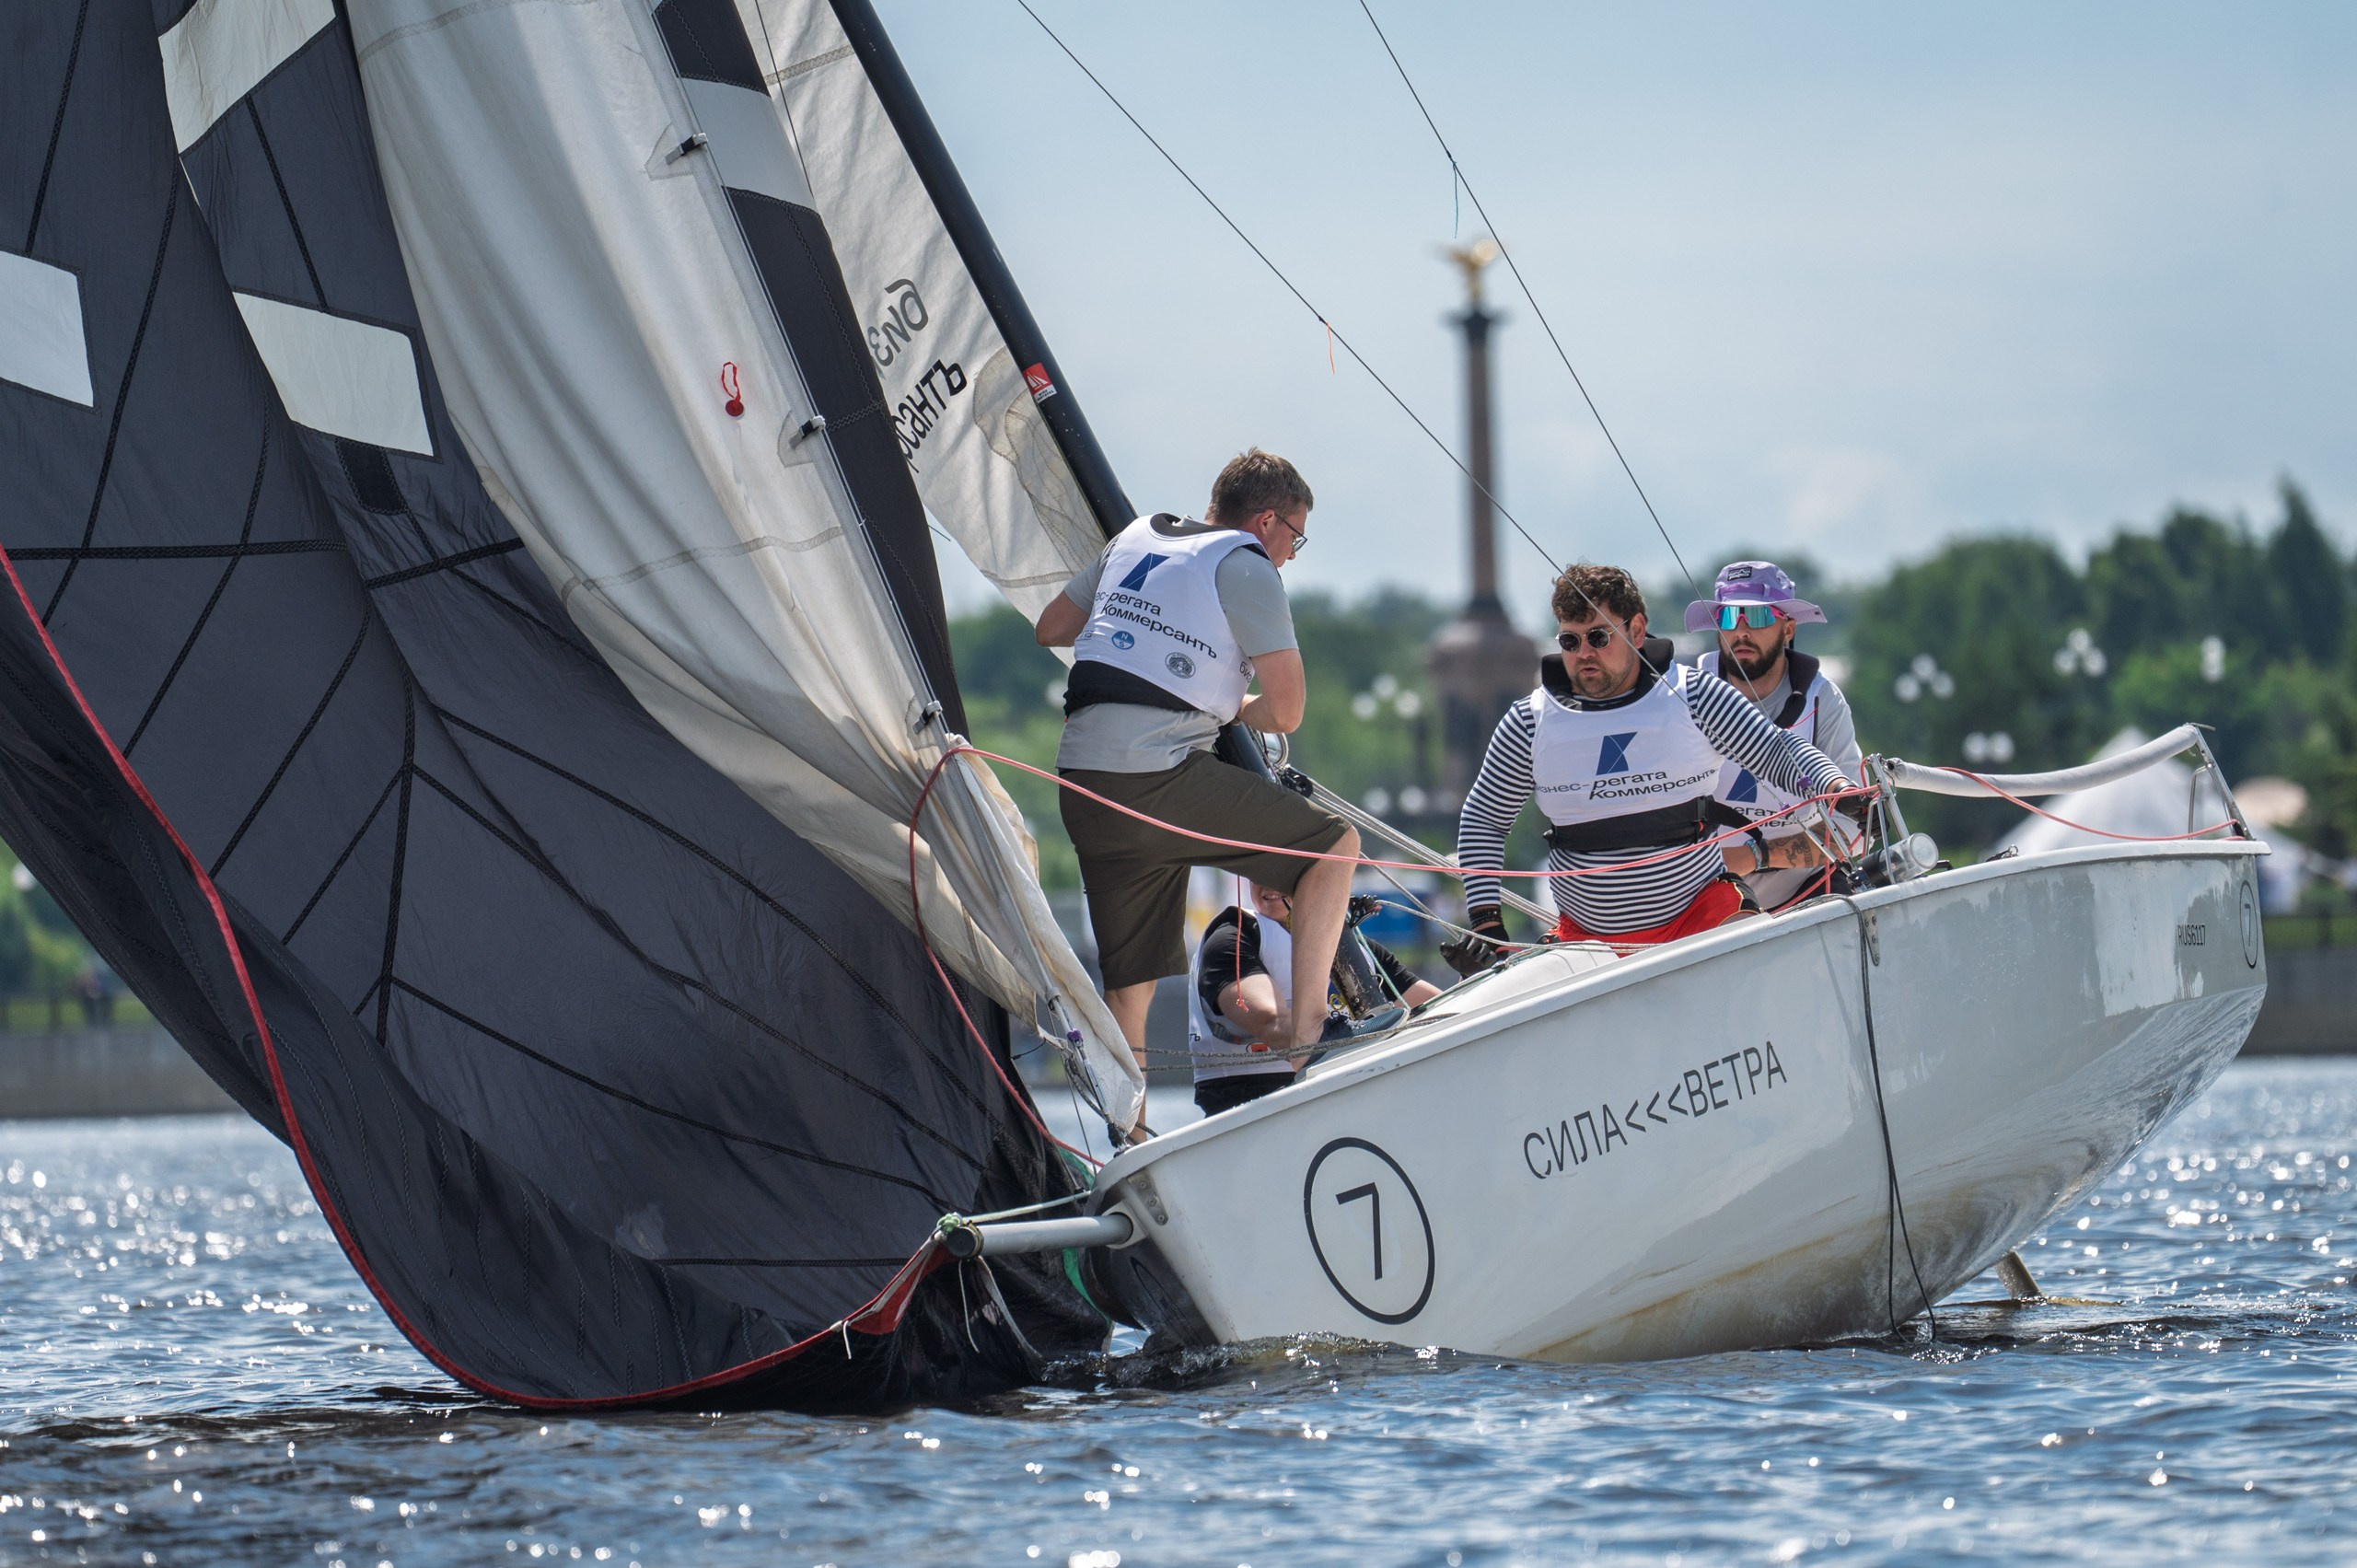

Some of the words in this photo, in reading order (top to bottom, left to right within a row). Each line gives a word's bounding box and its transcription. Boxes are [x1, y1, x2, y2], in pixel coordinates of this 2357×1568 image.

[1101, 604, 1217, 659] Коммерсантъ
[1589, 769, 1715, 800] Коммерсантъ
[2177, 924, 2206, 947] RUS6117
[2244, 903, 2252, 947] 7
[1335, 1181, 1383, 1281] 7
